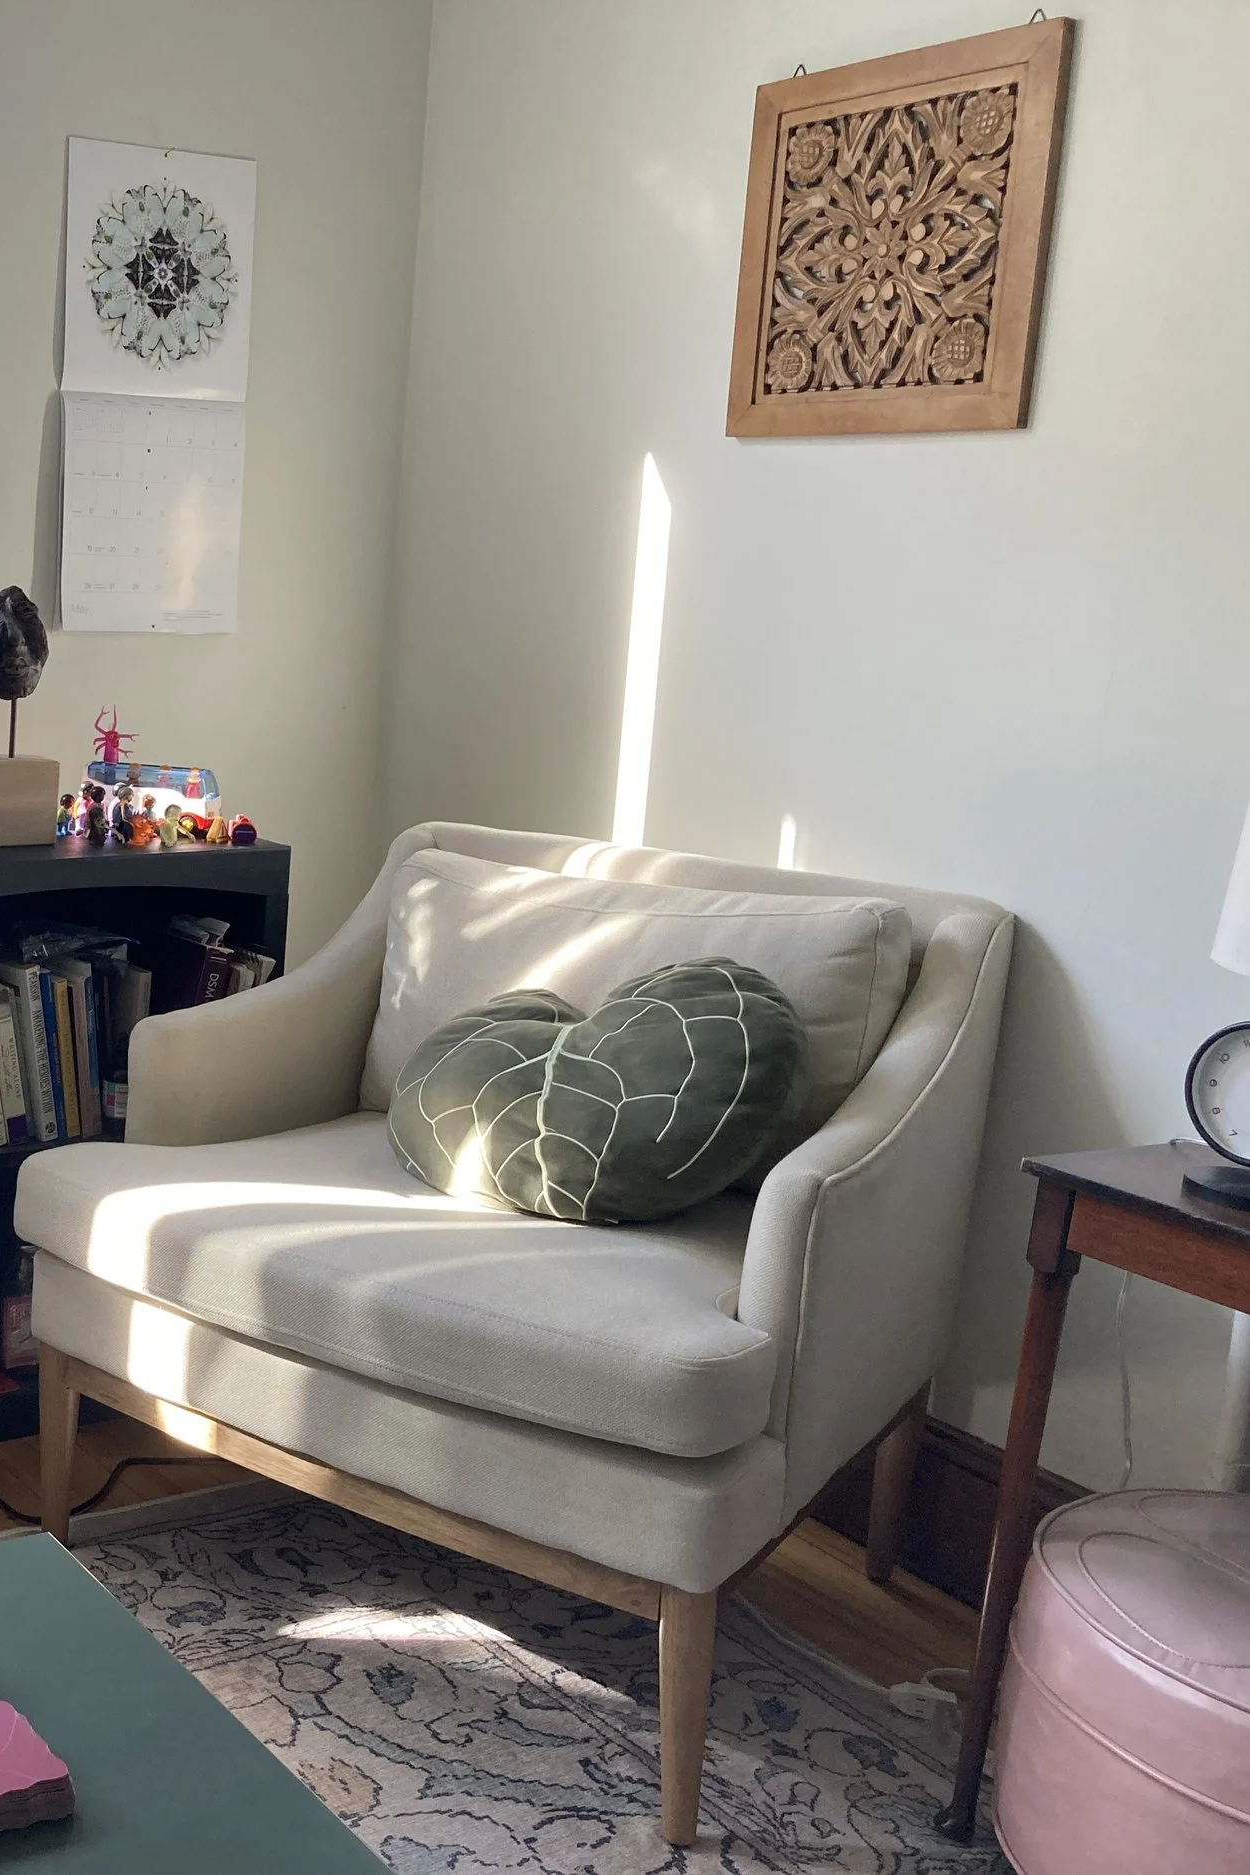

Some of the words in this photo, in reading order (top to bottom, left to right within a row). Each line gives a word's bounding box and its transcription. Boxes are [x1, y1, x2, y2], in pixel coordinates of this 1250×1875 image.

[28, 971, 40, 1001] PEARSON
[205, 973, 219, 998] DSM
[32, 1009, 46, 1048] AWAKENING
[36, 1049, 47, 1062] THE
[1219, 1053, 1230, 1064] 10
[38, 1063, 50, 1089] HEROES
[1209, 1079, 1218, 1087] 9
[40, 1088, 55, 1114] WITHIN
[1212, 1107, 1221, 1115] 8
